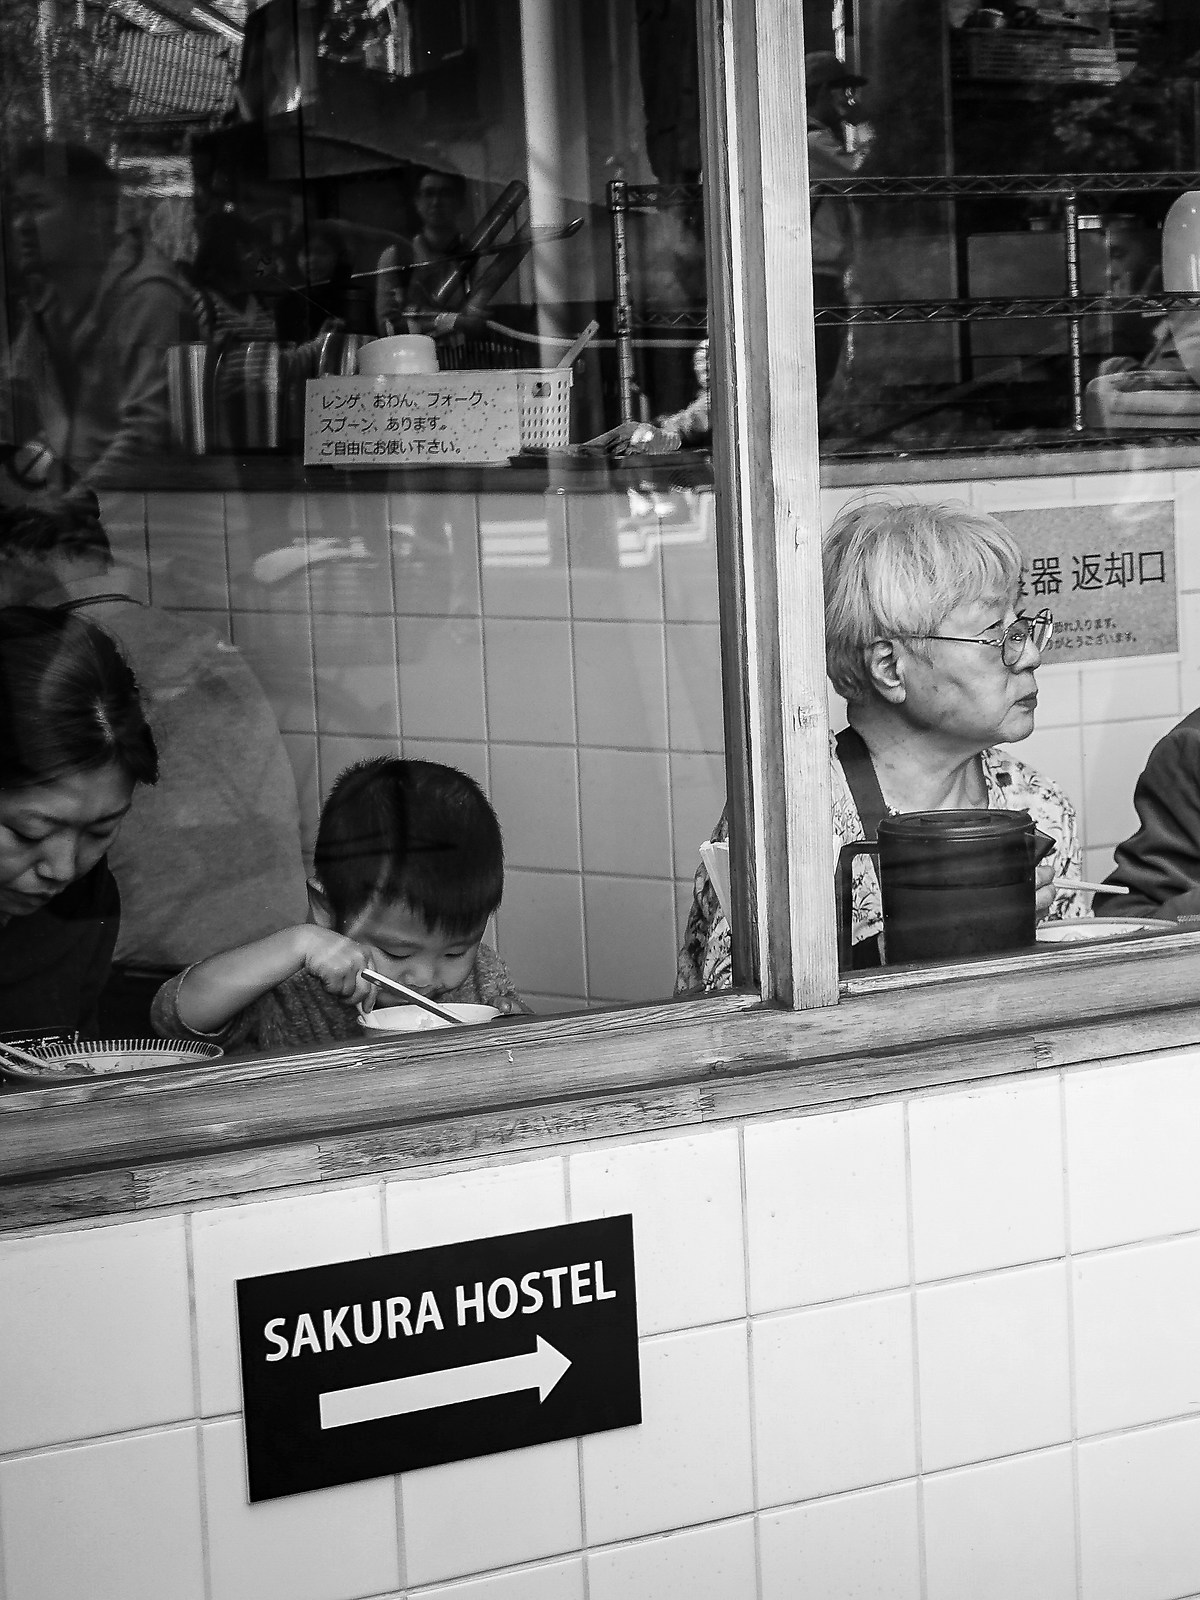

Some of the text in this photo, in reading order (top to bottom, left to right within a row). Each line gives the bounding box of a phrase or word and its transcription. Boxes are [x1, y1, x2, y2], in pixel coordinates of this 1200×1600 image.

[320, 440, 462, 457] ご自由にお使い下さい。
[1071, 551, 1165, 591] 返却口
[264, 1260, 617, 1361] SAKURA HOSTEL
